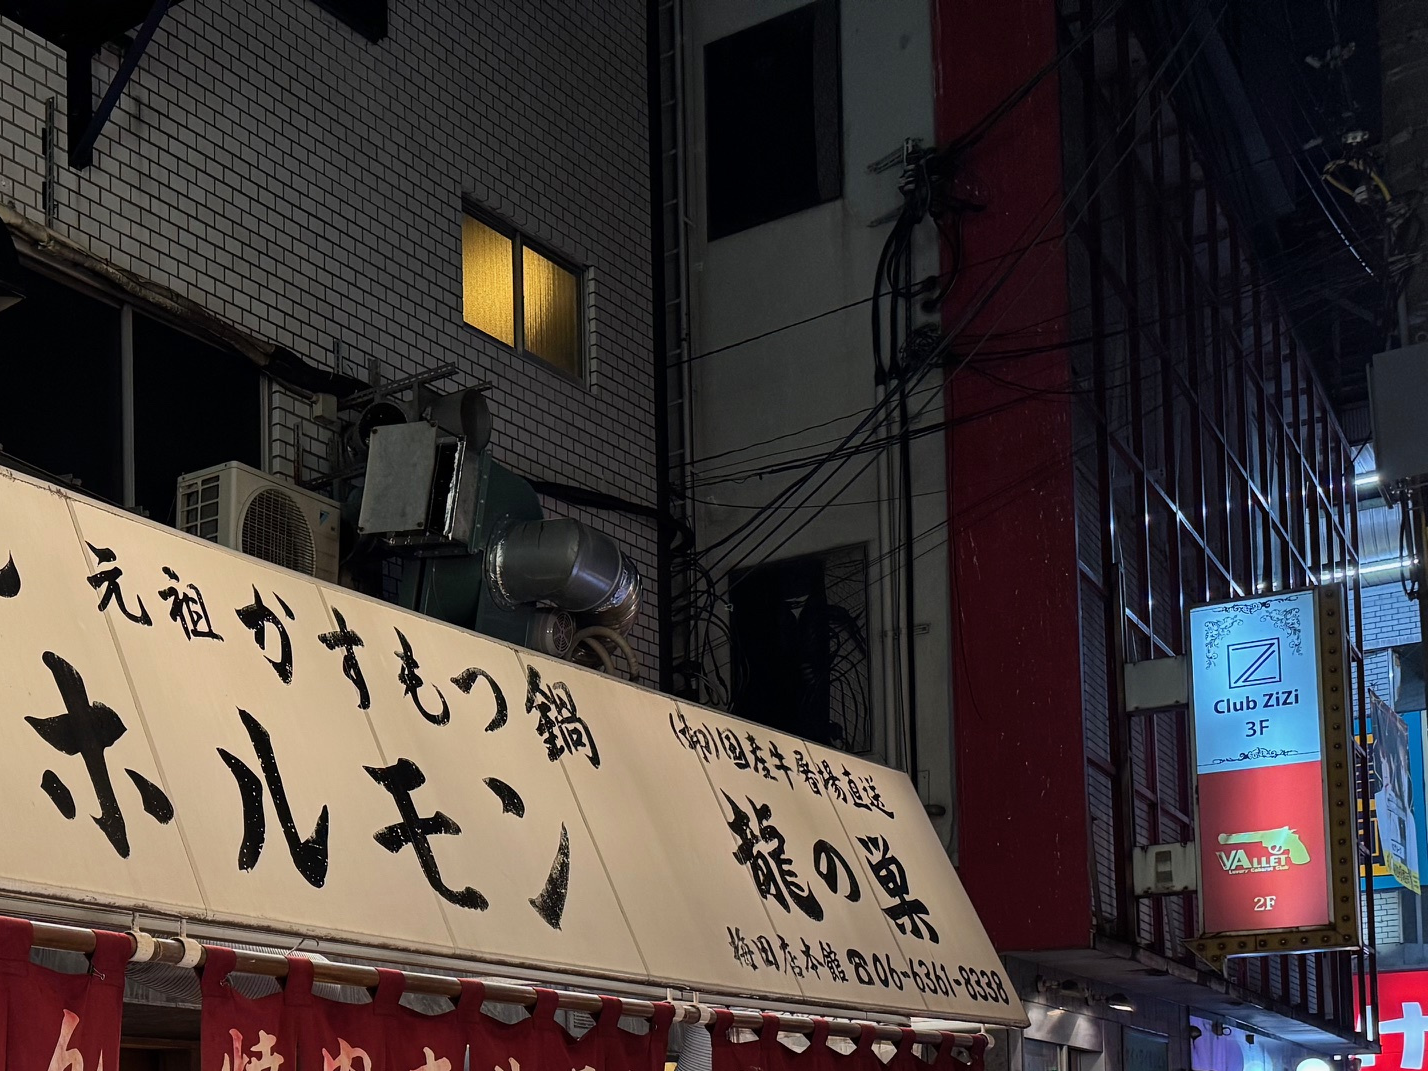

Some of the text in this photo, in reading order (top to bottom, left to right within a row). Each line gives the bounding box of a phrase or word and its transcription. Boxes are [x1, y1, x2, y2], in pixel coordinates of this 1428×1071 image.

[1214, 689, 1299, 715] Club ZiZi
[1245, 719, 1270, 738] 3F
[720, 788, 939, 944] 龍の巣
[1254, 896, 1276, 911] 2F
